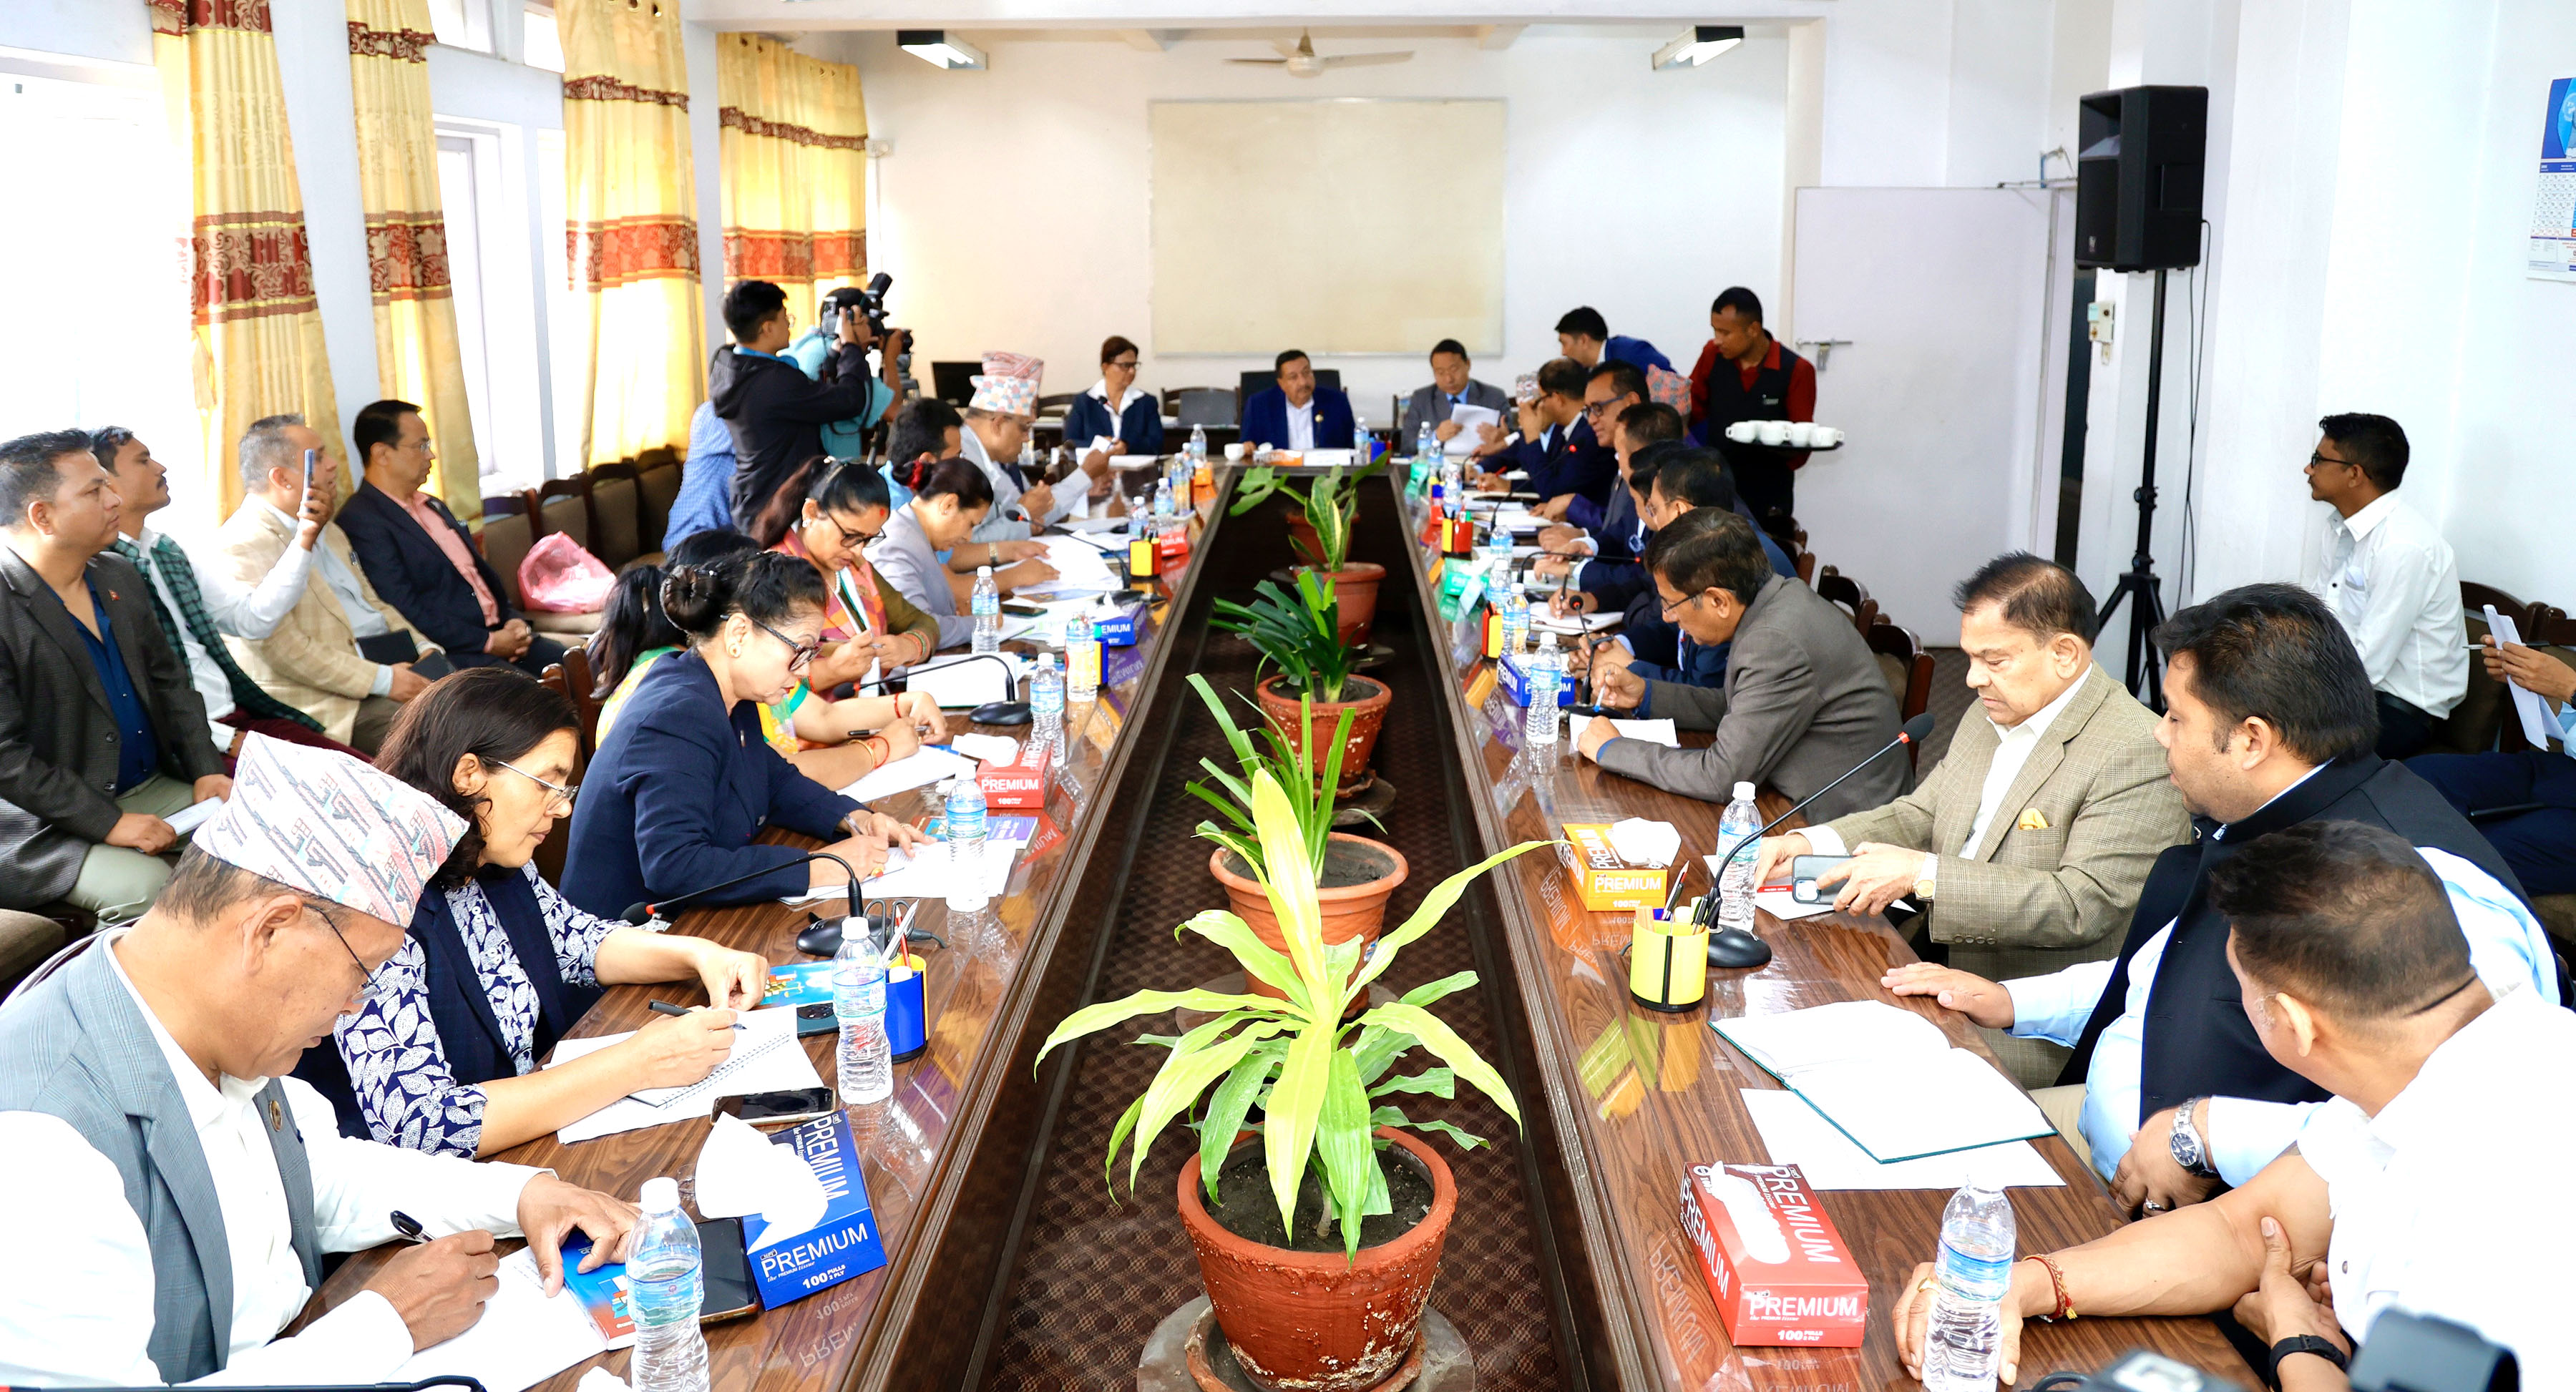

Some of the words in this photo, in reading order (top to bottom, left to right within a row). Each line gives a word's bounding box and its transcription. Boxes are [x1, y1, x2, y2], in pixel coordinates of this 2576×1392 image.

[1101, 624, 1131, 634] EMIUM
[981, 779, 1039, 790] PREMIUM
[1575, 829, 1618, 868] PREMIUM
[1594, 877, 1661, 890] PREMIUM
[802, 1115, 850, 1201] PREMIUM
[1765, 1167, 1841, 1263] PREMIUM
[1682, 1178, 1729, 1300] PREMIUM
[761, 1222, 868, 1278] PREMIUM
[778, 1267, 798, 1278] PREMIUM
[798, 1261, 815, 1271] tissue
[802, 1272, 828, 1289] 100
[826, 1264, 847, 1275] PULLS
[834, 1270, 845, 1279] PLY
[1750, 1297, 1858, 1317] PREMIUM
[1777, 1330, 1803, 1340] 100
